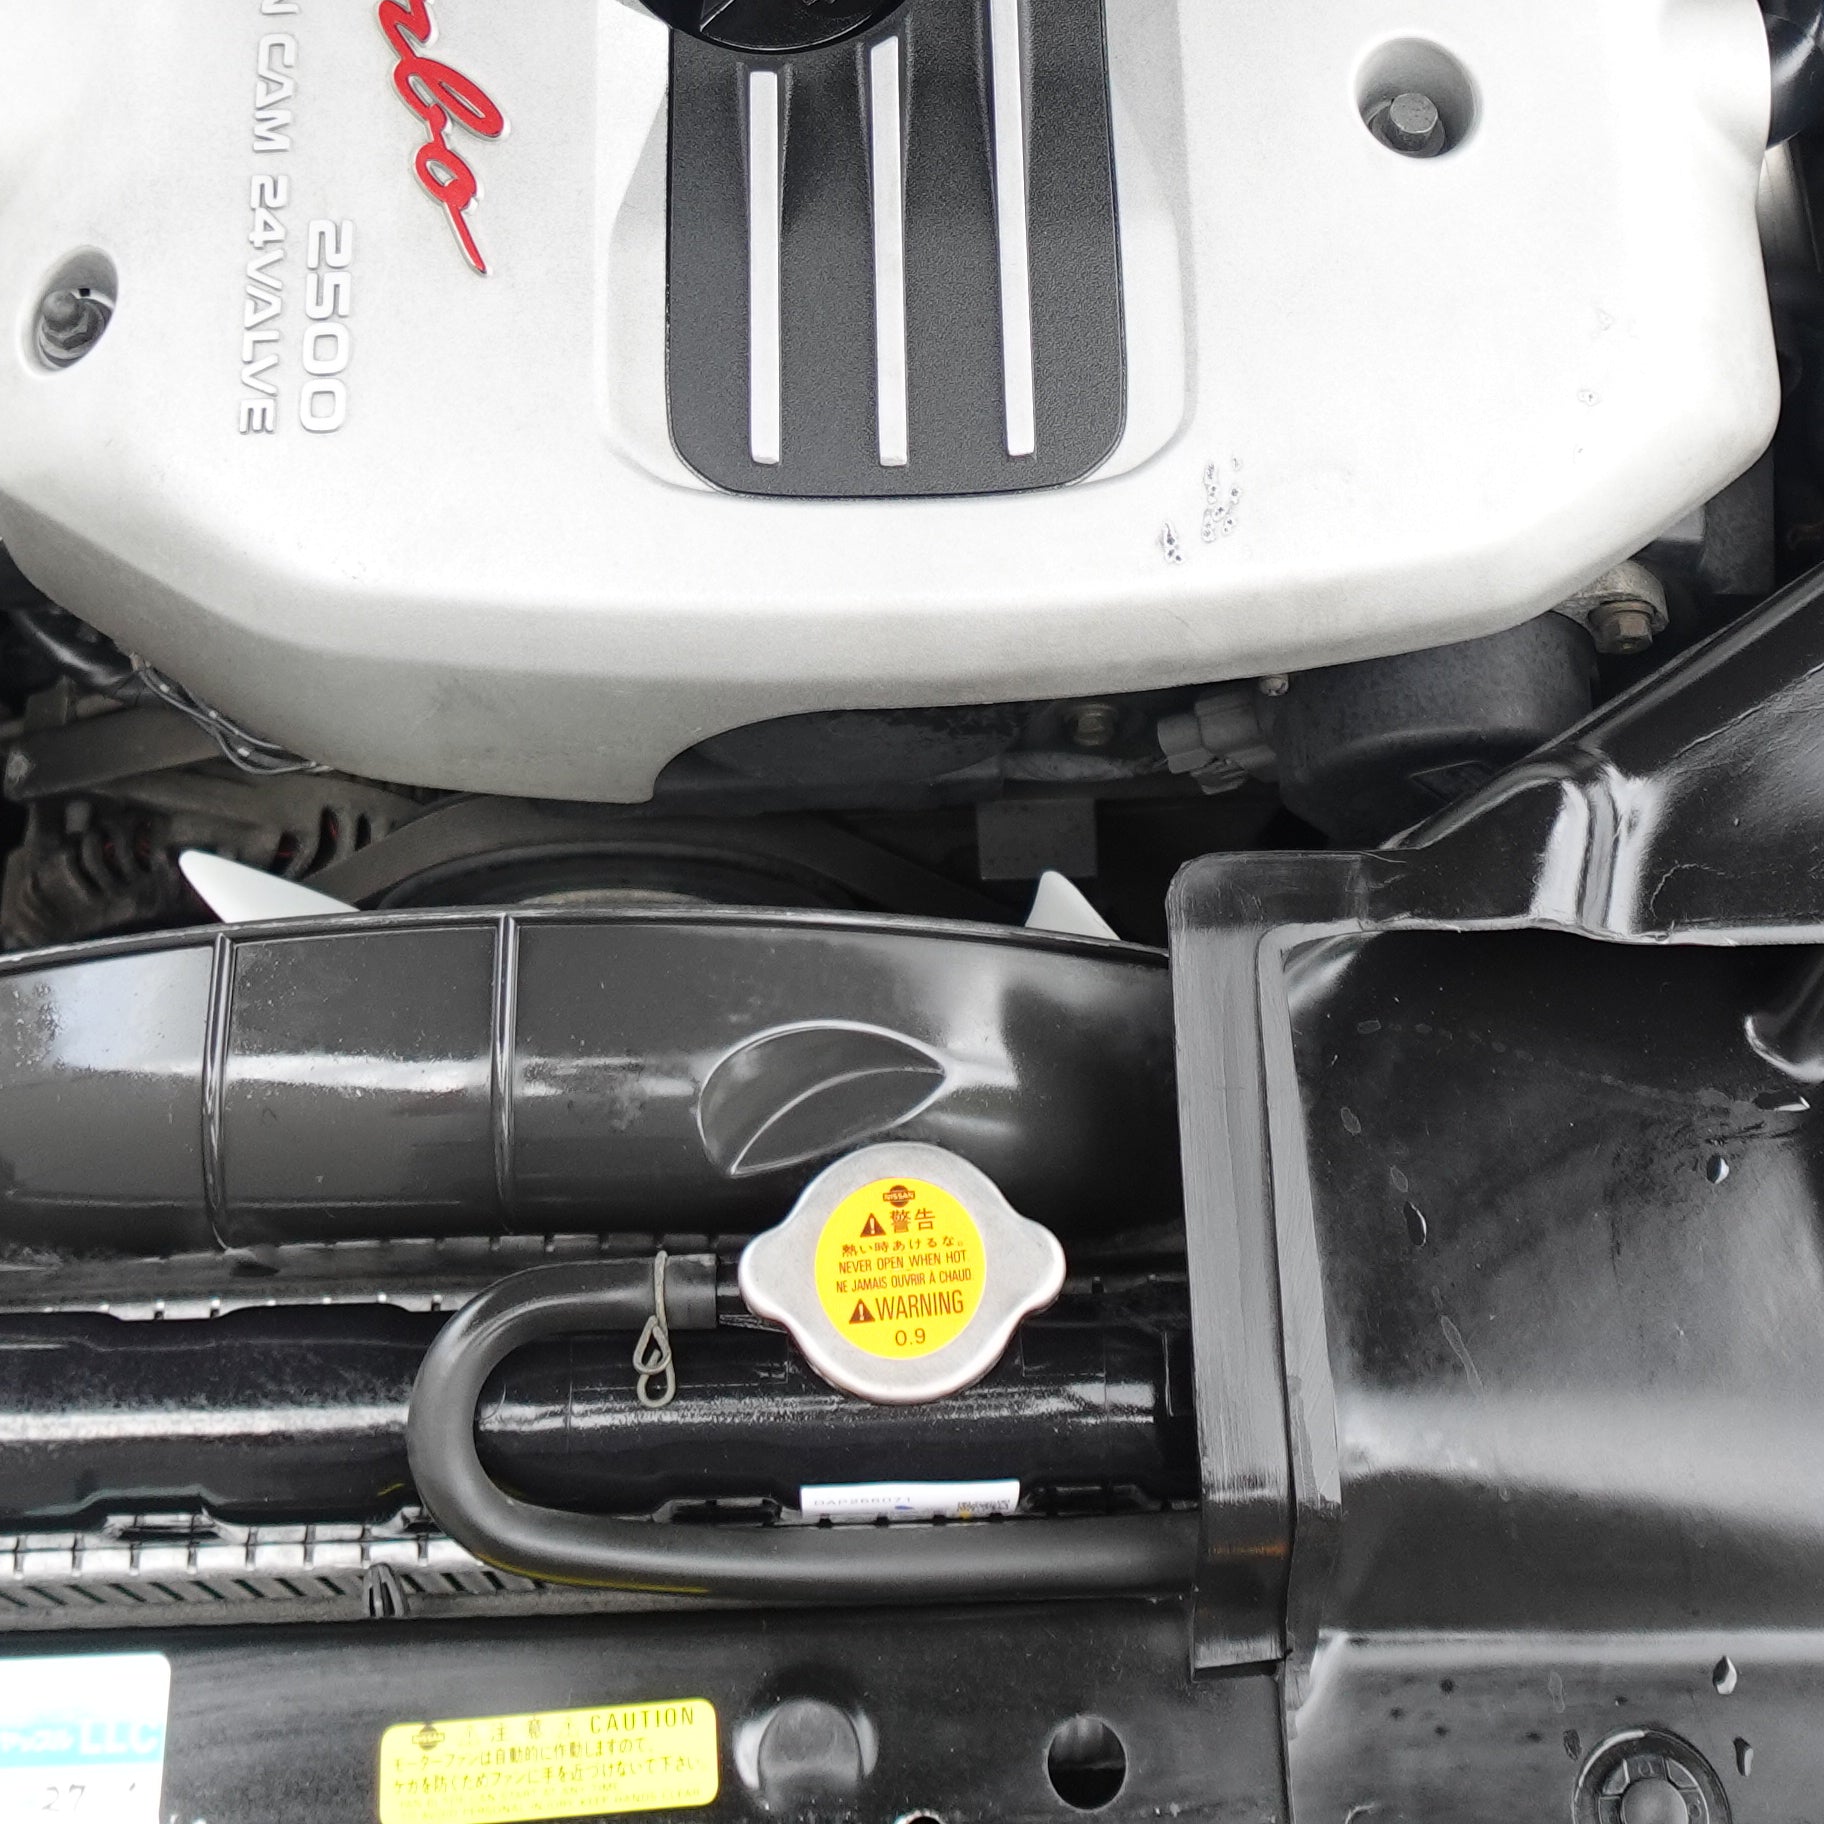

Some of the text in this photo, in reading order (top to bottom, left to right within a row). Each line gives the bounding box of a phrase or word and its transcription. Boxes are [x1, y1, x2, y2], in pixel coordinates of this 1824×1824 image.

[250, 32, 299, 156] CAM
[237, 172, 291, 438] 24VALVE
[298, 217, 356, 436] 2500
[883, 1191, 915, 1202] NISSAN
[889, 1207, 936, 1234] 警告
[842, 1235, 964, 1258] 熱い時あけるな。
[838, 1249, 967, 1275] NEVER OPEN WHEN HOT
[836, 1280, 848, 1293] NE
[851, 1276, 888, 1292] JAMAIS
[891, 1272, 926, 1288] OUVRIR
[875, 1289, 964, 1322] WARNING
[894, 1327, 927, 1347] 0.9
[589, 1705, 695, 1734] CAUTION
[79, 1719, 160, 1756] LLC
